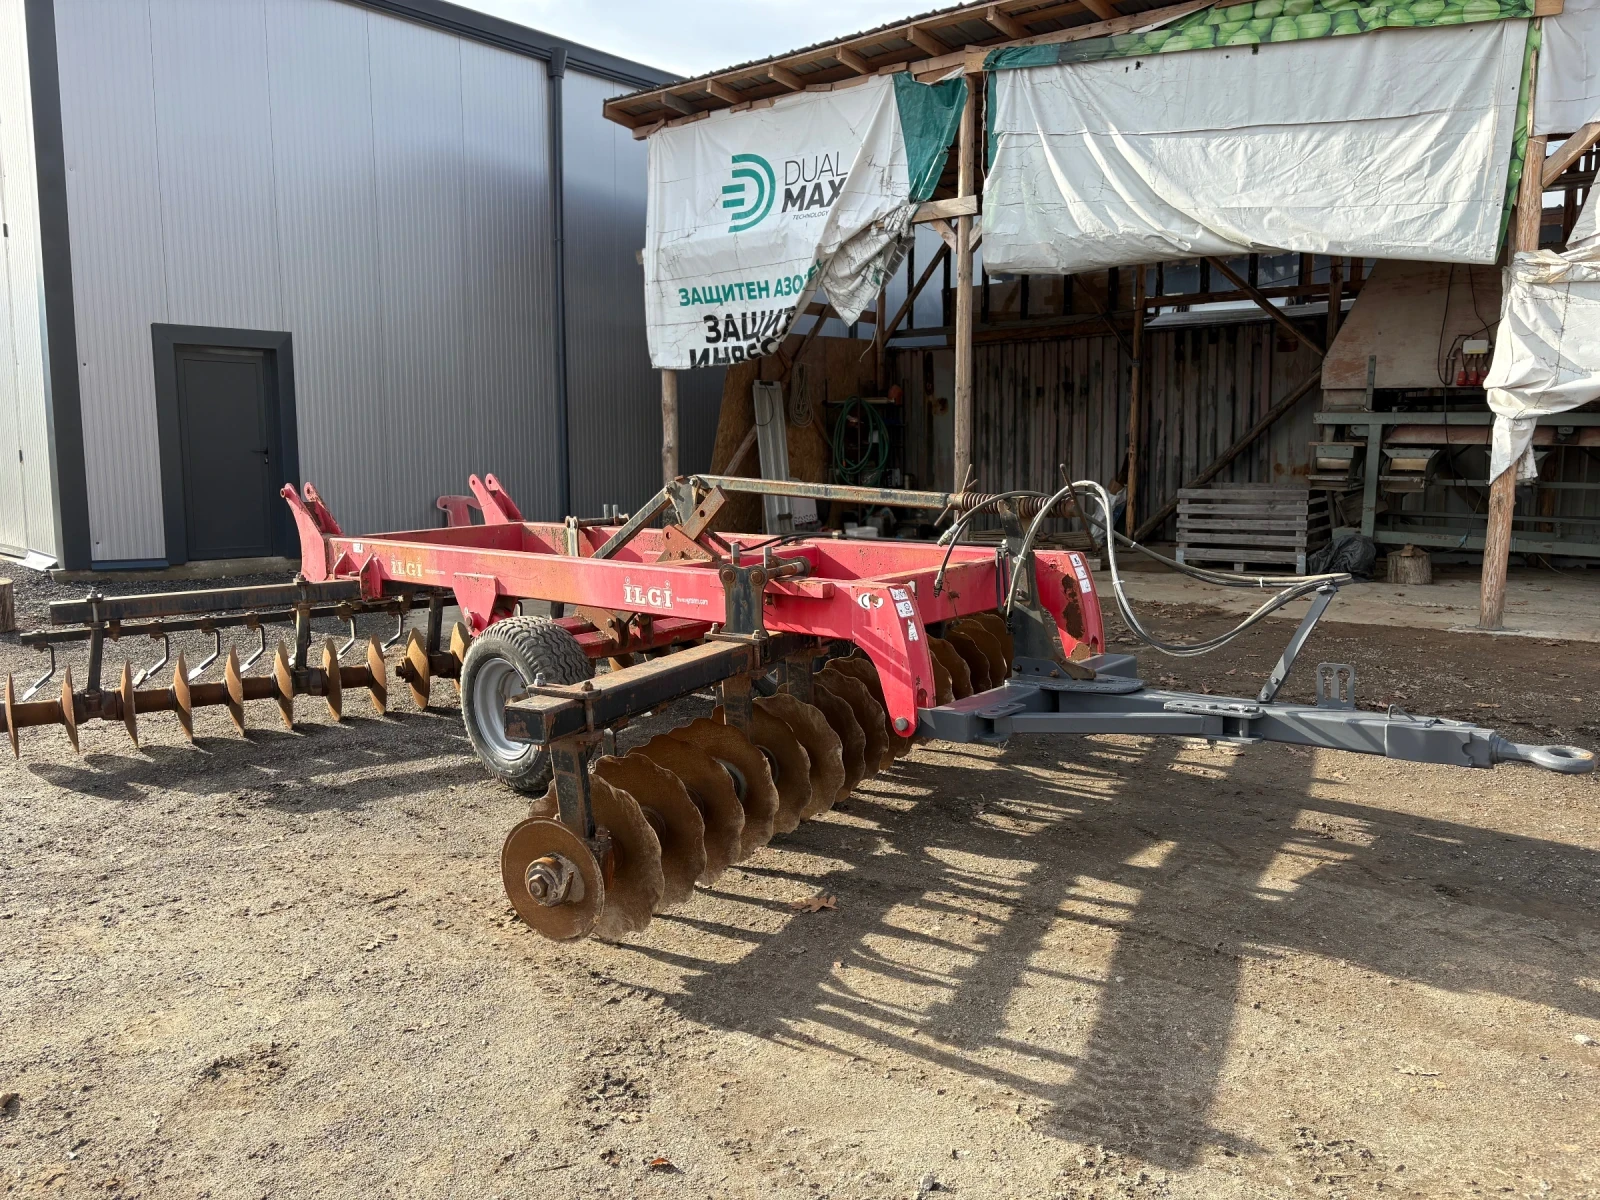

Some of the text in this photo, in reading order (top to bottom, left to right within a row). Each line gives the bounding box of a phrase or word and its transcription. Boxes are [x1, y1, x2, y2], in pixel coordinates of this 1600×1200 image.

[784, 151, 849, 187] DUAL
[781, 176, 848, 214] MAX
[792, 210, 830, 221] TECHNOLOGY
[678, 279, 770, 307] ЗАЩИТЕН
